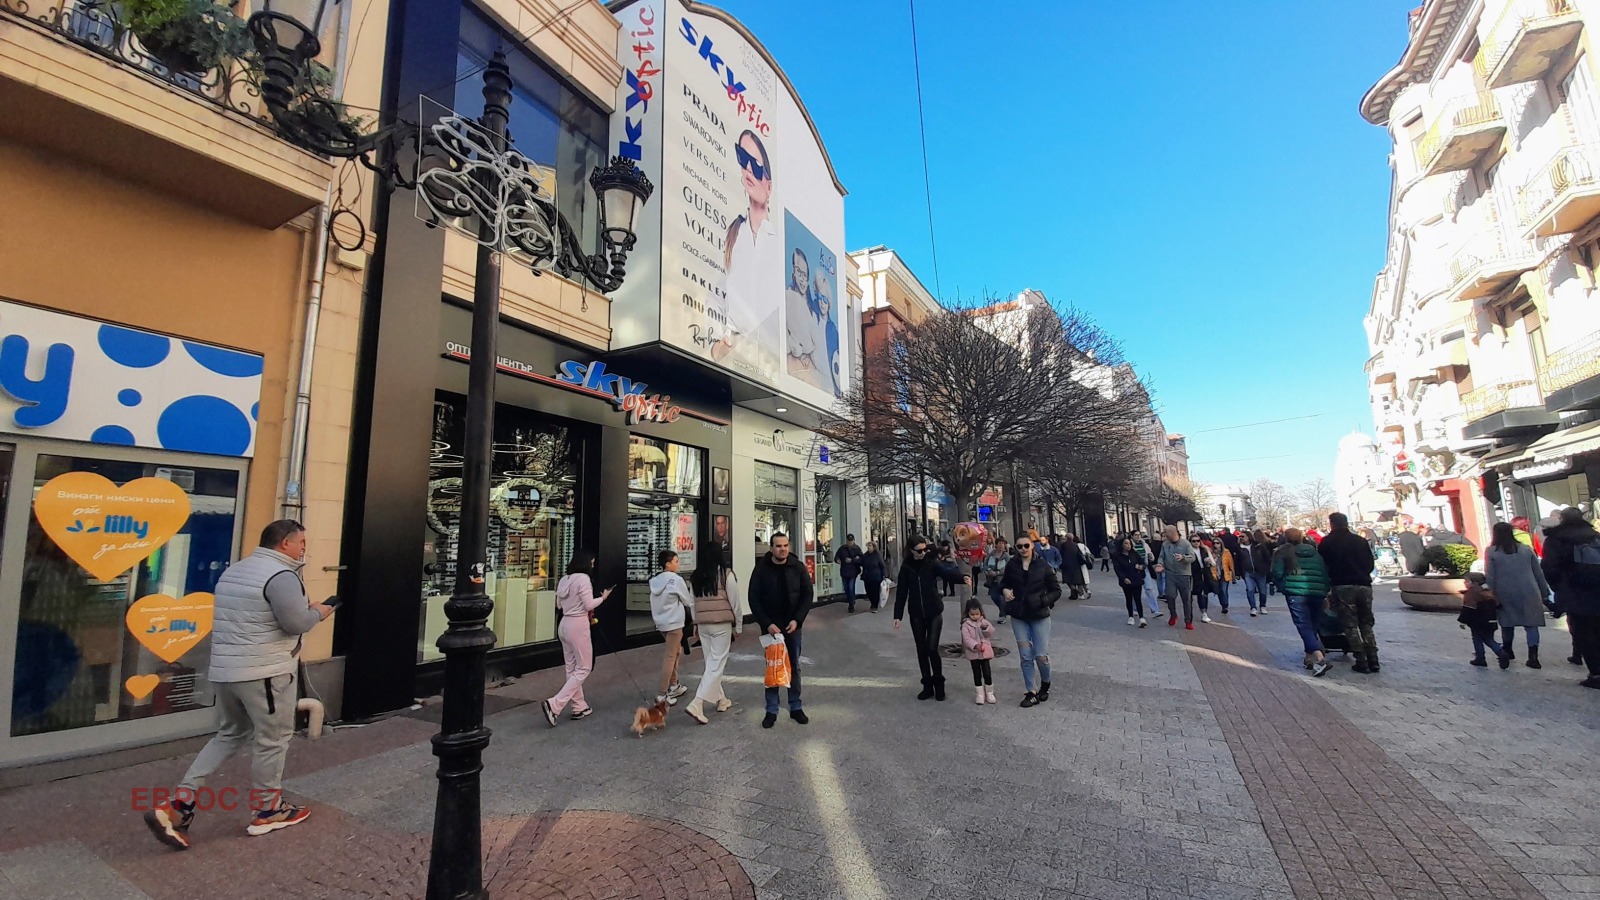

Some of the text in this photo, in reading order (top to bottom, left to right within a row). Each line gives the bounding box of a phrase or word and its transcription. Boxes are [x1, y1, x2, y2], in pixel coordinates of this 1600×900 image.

[631, 4, 662, 101] optic
[679, 17, 747, 94] sky
[619, 68, 648, 178] ky
[683, 82, 726, 135] PRADA
[727, 84, 770, 138] optic
[683, 110, 726, 158] SWAROVSKI
[683, 135, 727, 182] VERSACE
[682, 161, 728, 206] MICHAEL KORS
[682, 185, 727, 230] GUESS
[684, 212, 726, 254] VOGUE
[682, 267, 727, 300] OAKLEY
[496, 355, 533, 372] ЦЕНТЪР
[556, 360, 648, 404] sky
[622, 393, 681, 424] optic
[57, 490, 175, 505] Винаги ниски цени
[104, 515, 149, 539] lilly
[169, 619, 197, 633] lilly
